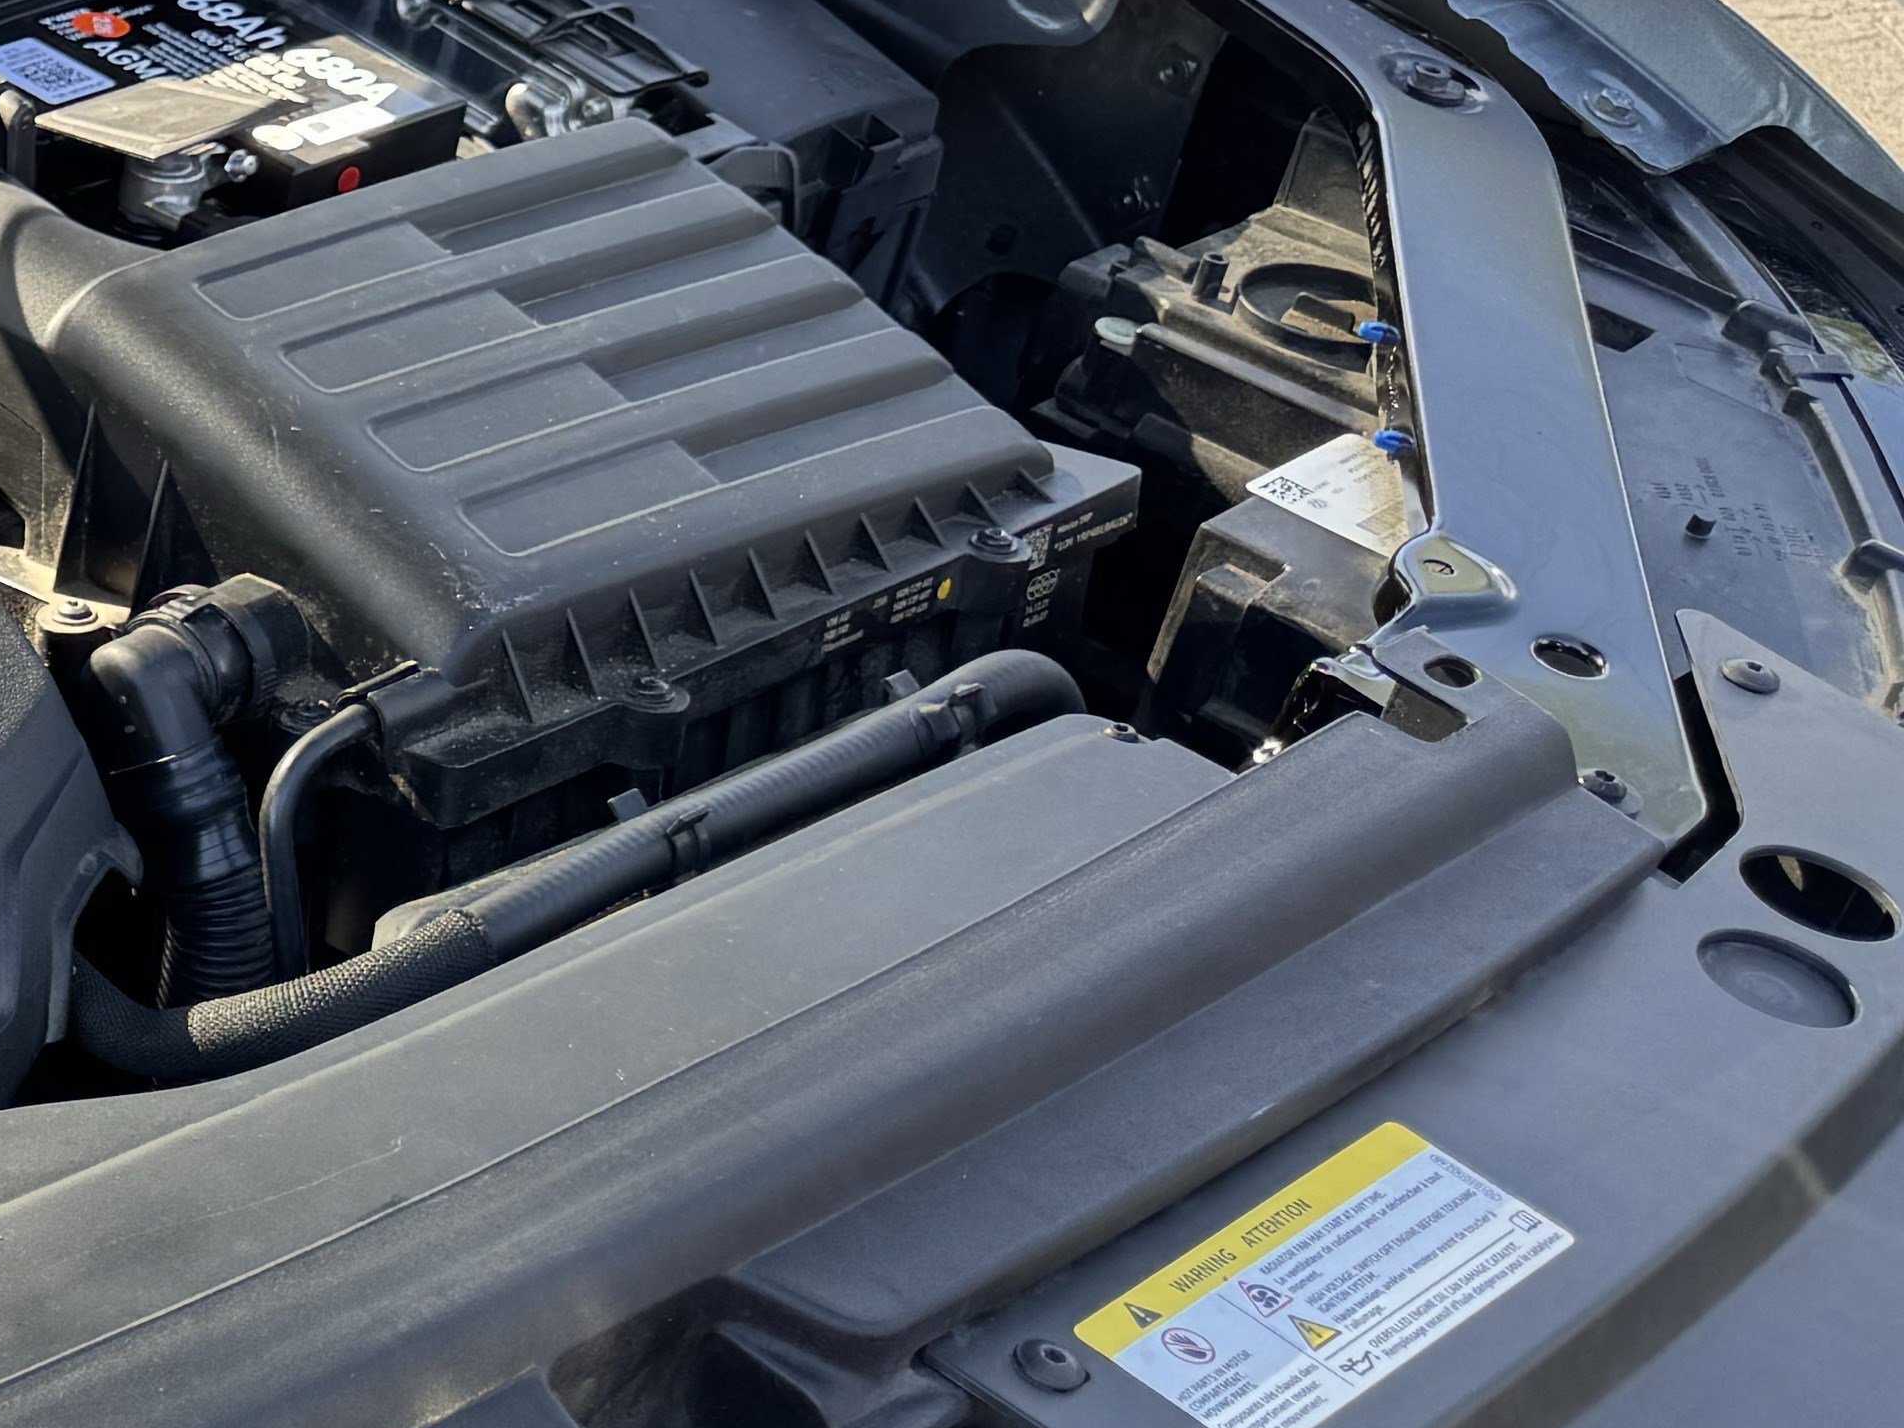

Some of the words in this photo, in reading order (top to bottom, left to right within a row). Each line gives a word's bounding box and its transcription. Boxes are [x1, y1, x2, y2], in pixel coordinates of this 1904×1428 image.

[82, 41, 168, 80] AGM
[283, 48, 398, 107] 680A
[1166, 1246, 1239, 1295] WARNING
[1235, 1196, 1315, 1249] ATTENTION
